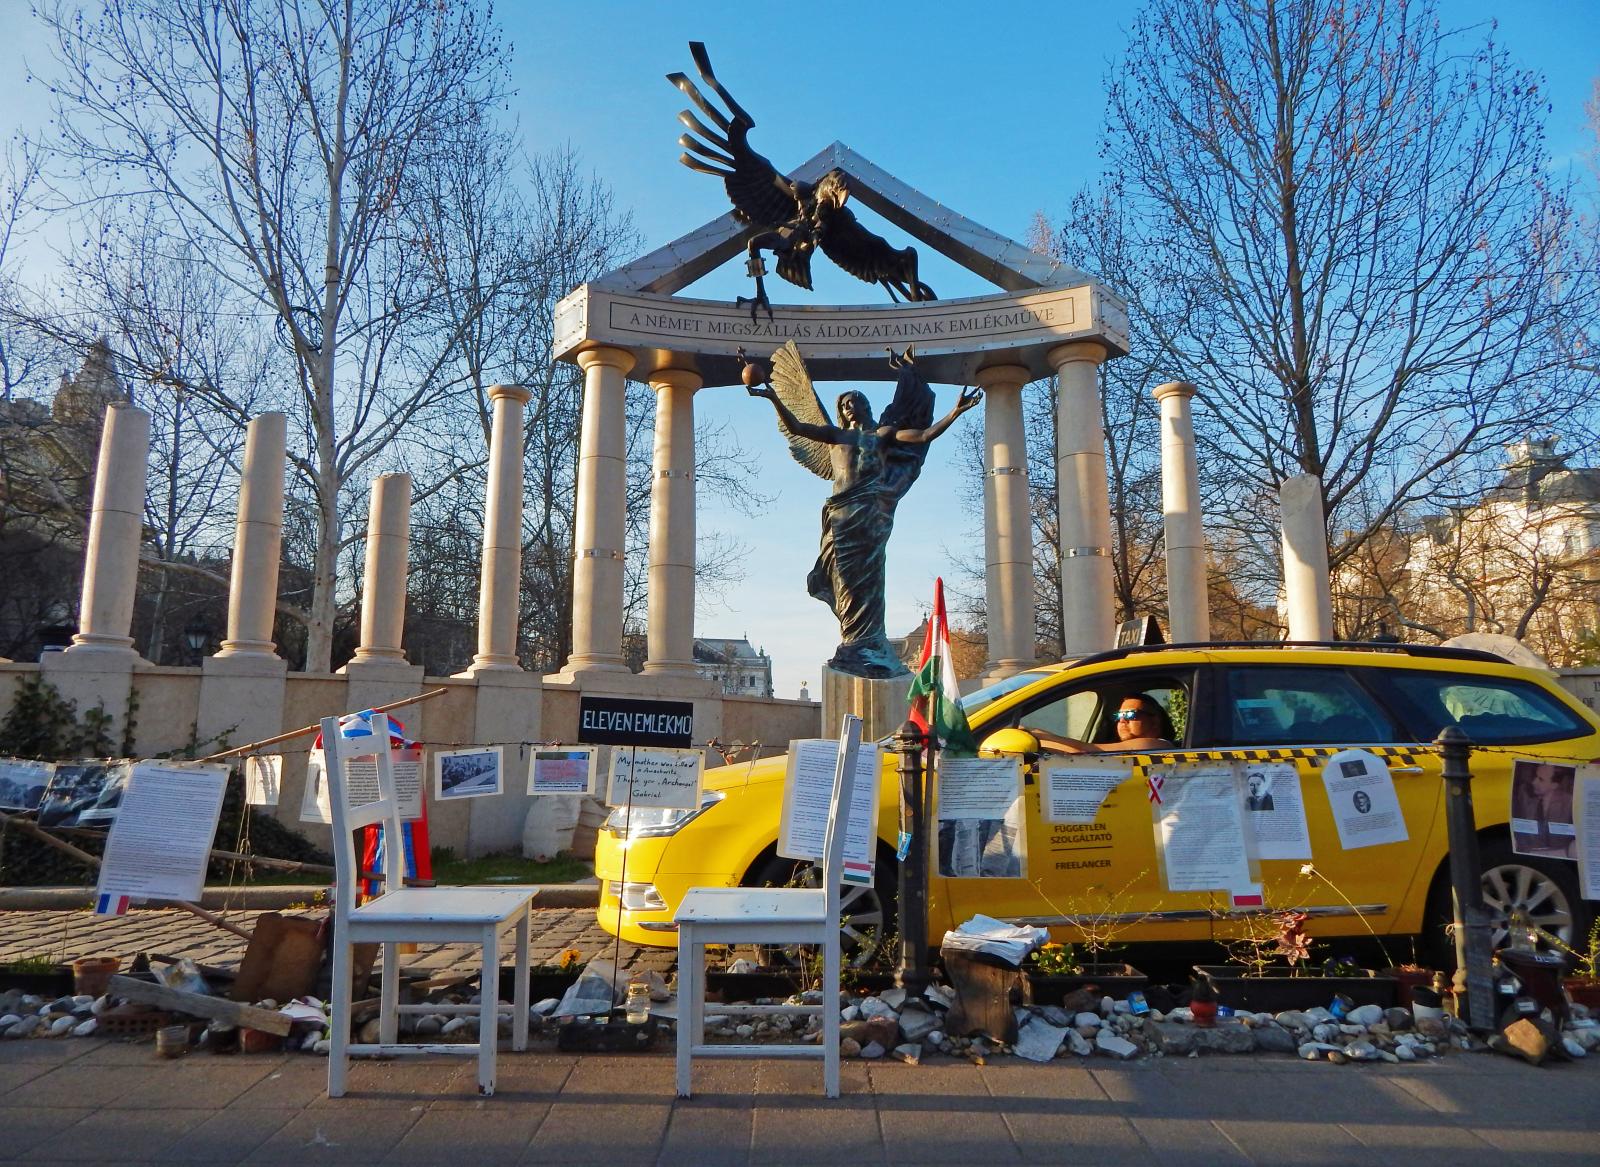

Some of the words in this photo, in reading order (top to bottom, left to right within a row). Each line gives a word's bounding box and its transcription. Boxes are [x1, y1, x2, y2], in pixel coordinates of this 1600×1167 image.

[630, 312, 641, 326] A
[646, 313, 703, 332] NÉMET
[708, 319, 811, 338] MEGSZÁLLÁS
[816, 320, 944, 338] ÁLDOZATAINAK
[1120, 628, 1140, 647] TAXI
[583, 710, 633, 731] ELEVEN
[617, 756, 631, 767] My
[635, 757, 659, 766] mother
[1054, 823, 1106, 833] FÜGGETLEN
[1050, 833, 1112, 844] SZOLGÁLTATÓ
[1055, 859, 1112, 870] FREELANCER
